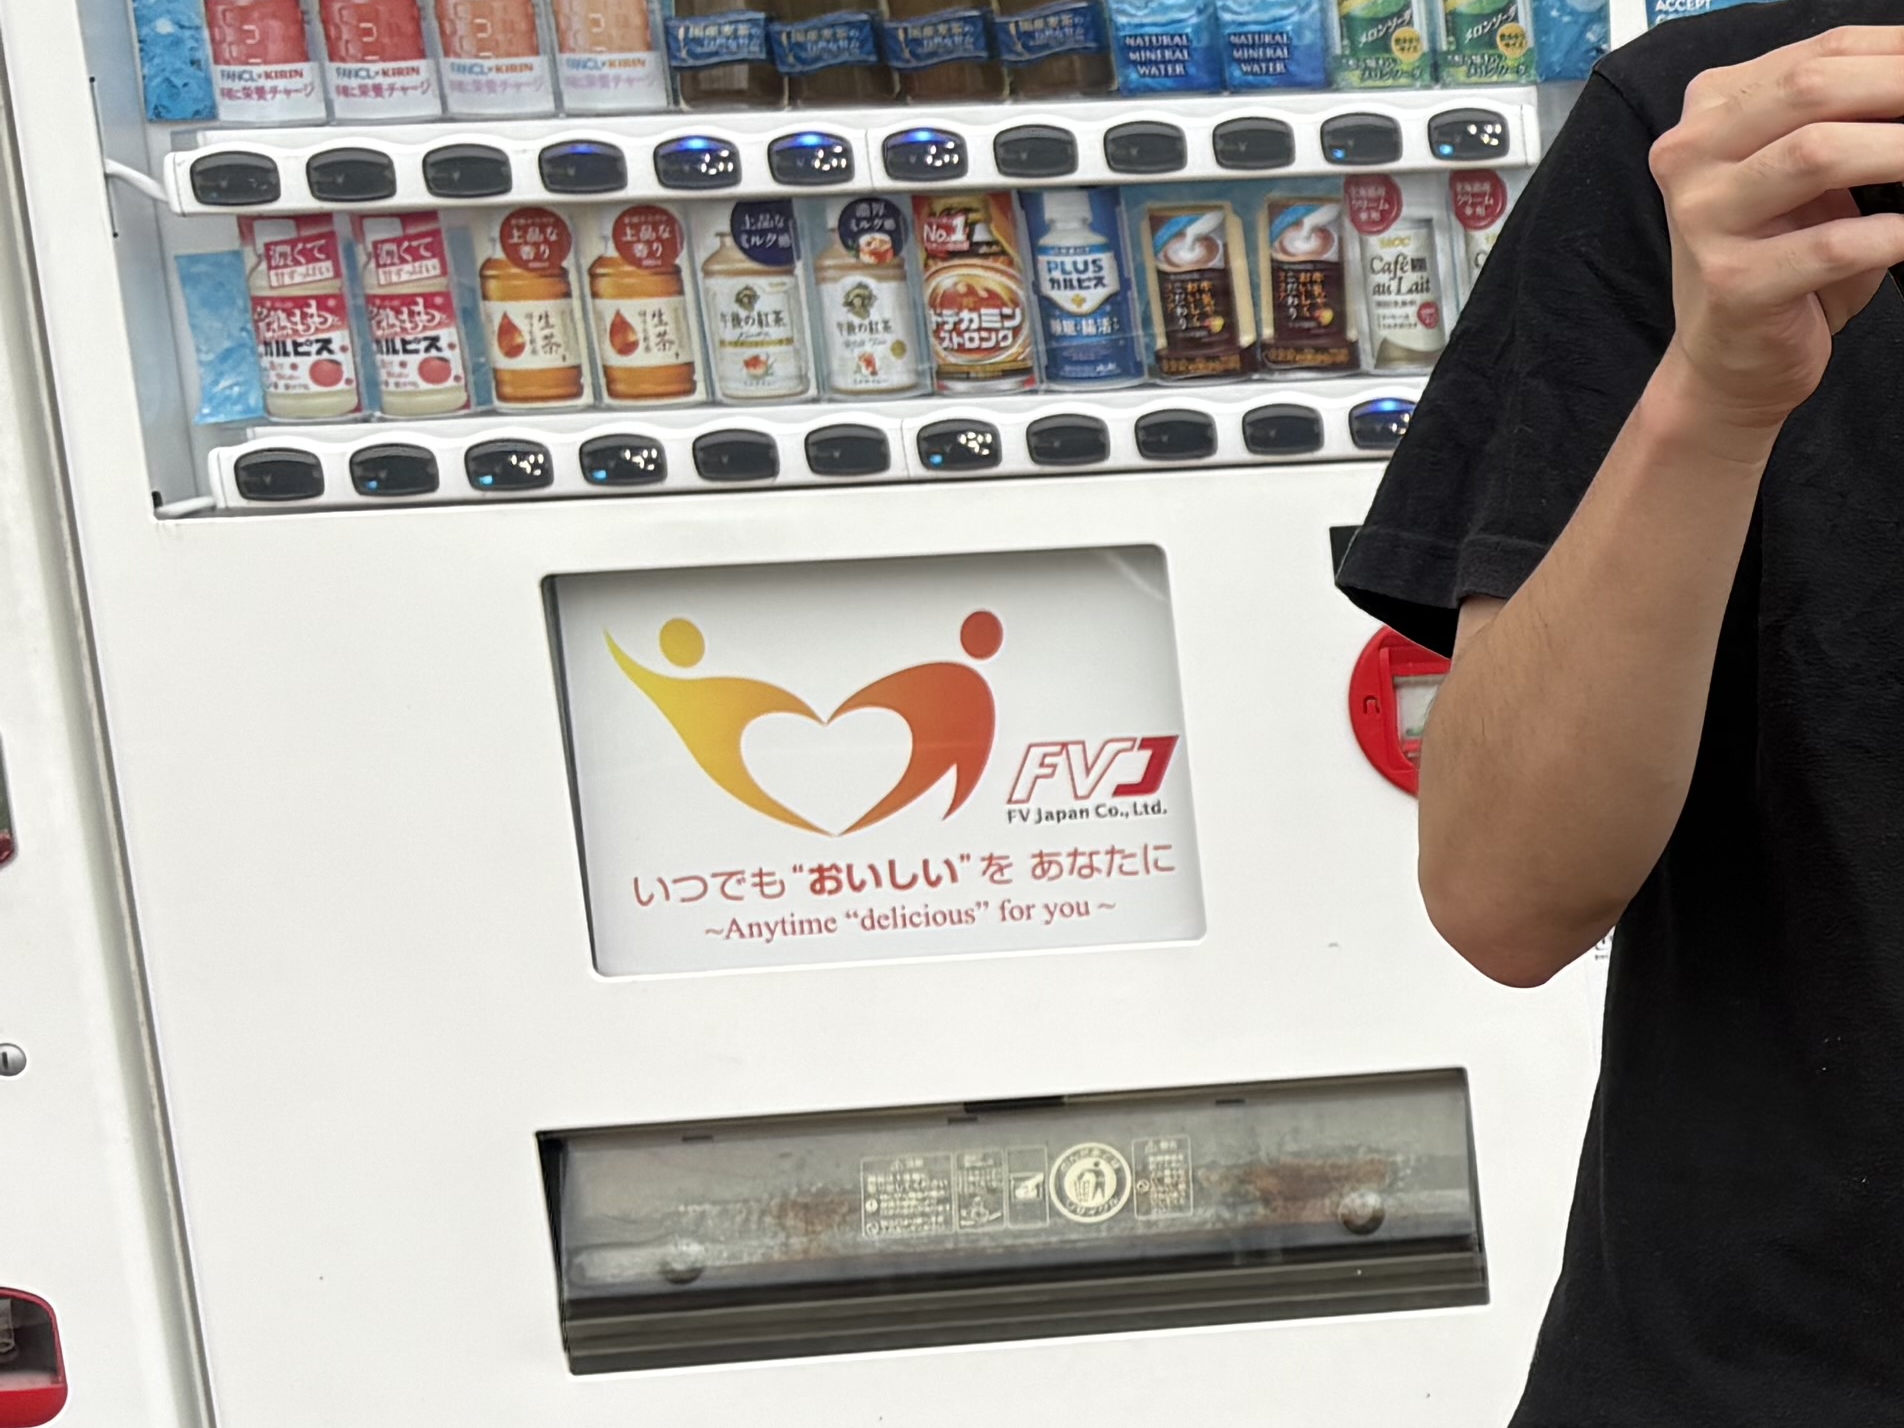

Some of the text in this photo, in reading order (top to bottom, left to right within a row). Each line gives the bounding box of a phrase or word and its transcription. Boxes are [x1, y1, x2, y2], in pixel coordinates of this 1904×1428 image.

[1136, 62, 1186, 77] WATER
[1240, 61, 1287, 75] WATER
[508, 226, 558, 244] 上品な
[622, 224, 671, 242] 上品な
[923, 212, 968, 243] No.1
[269, 239, 327, 267] 濃くて
[376, 237, 434, 266] 濃くて
[1046, 258, 1104, 276] PLUS
[1370, 252, 1410, 280] Café
[1047, 275, 1107, 292] カルピス
[1372, 275, 1431, 297] au Lait
[720, 310, 786, 329] 午後の紅茶
[836, 318, 893, 336] 午後の紅茶
[929, 307, 1022, 331] ドデカミン
[938, 329, 1014, 350] ストロング
[1007, 734, 1181, 805] FVJ
[1007, 808, 1032, 824] FV
[1035, 805, 1091, 826] Japan
[1133, 799, 1169, 818] Ltd.
[1030, 843, 1177, 883] あなたに
[999, 898, 1032, 923] for
[1041, 902, 1090, 926] you
